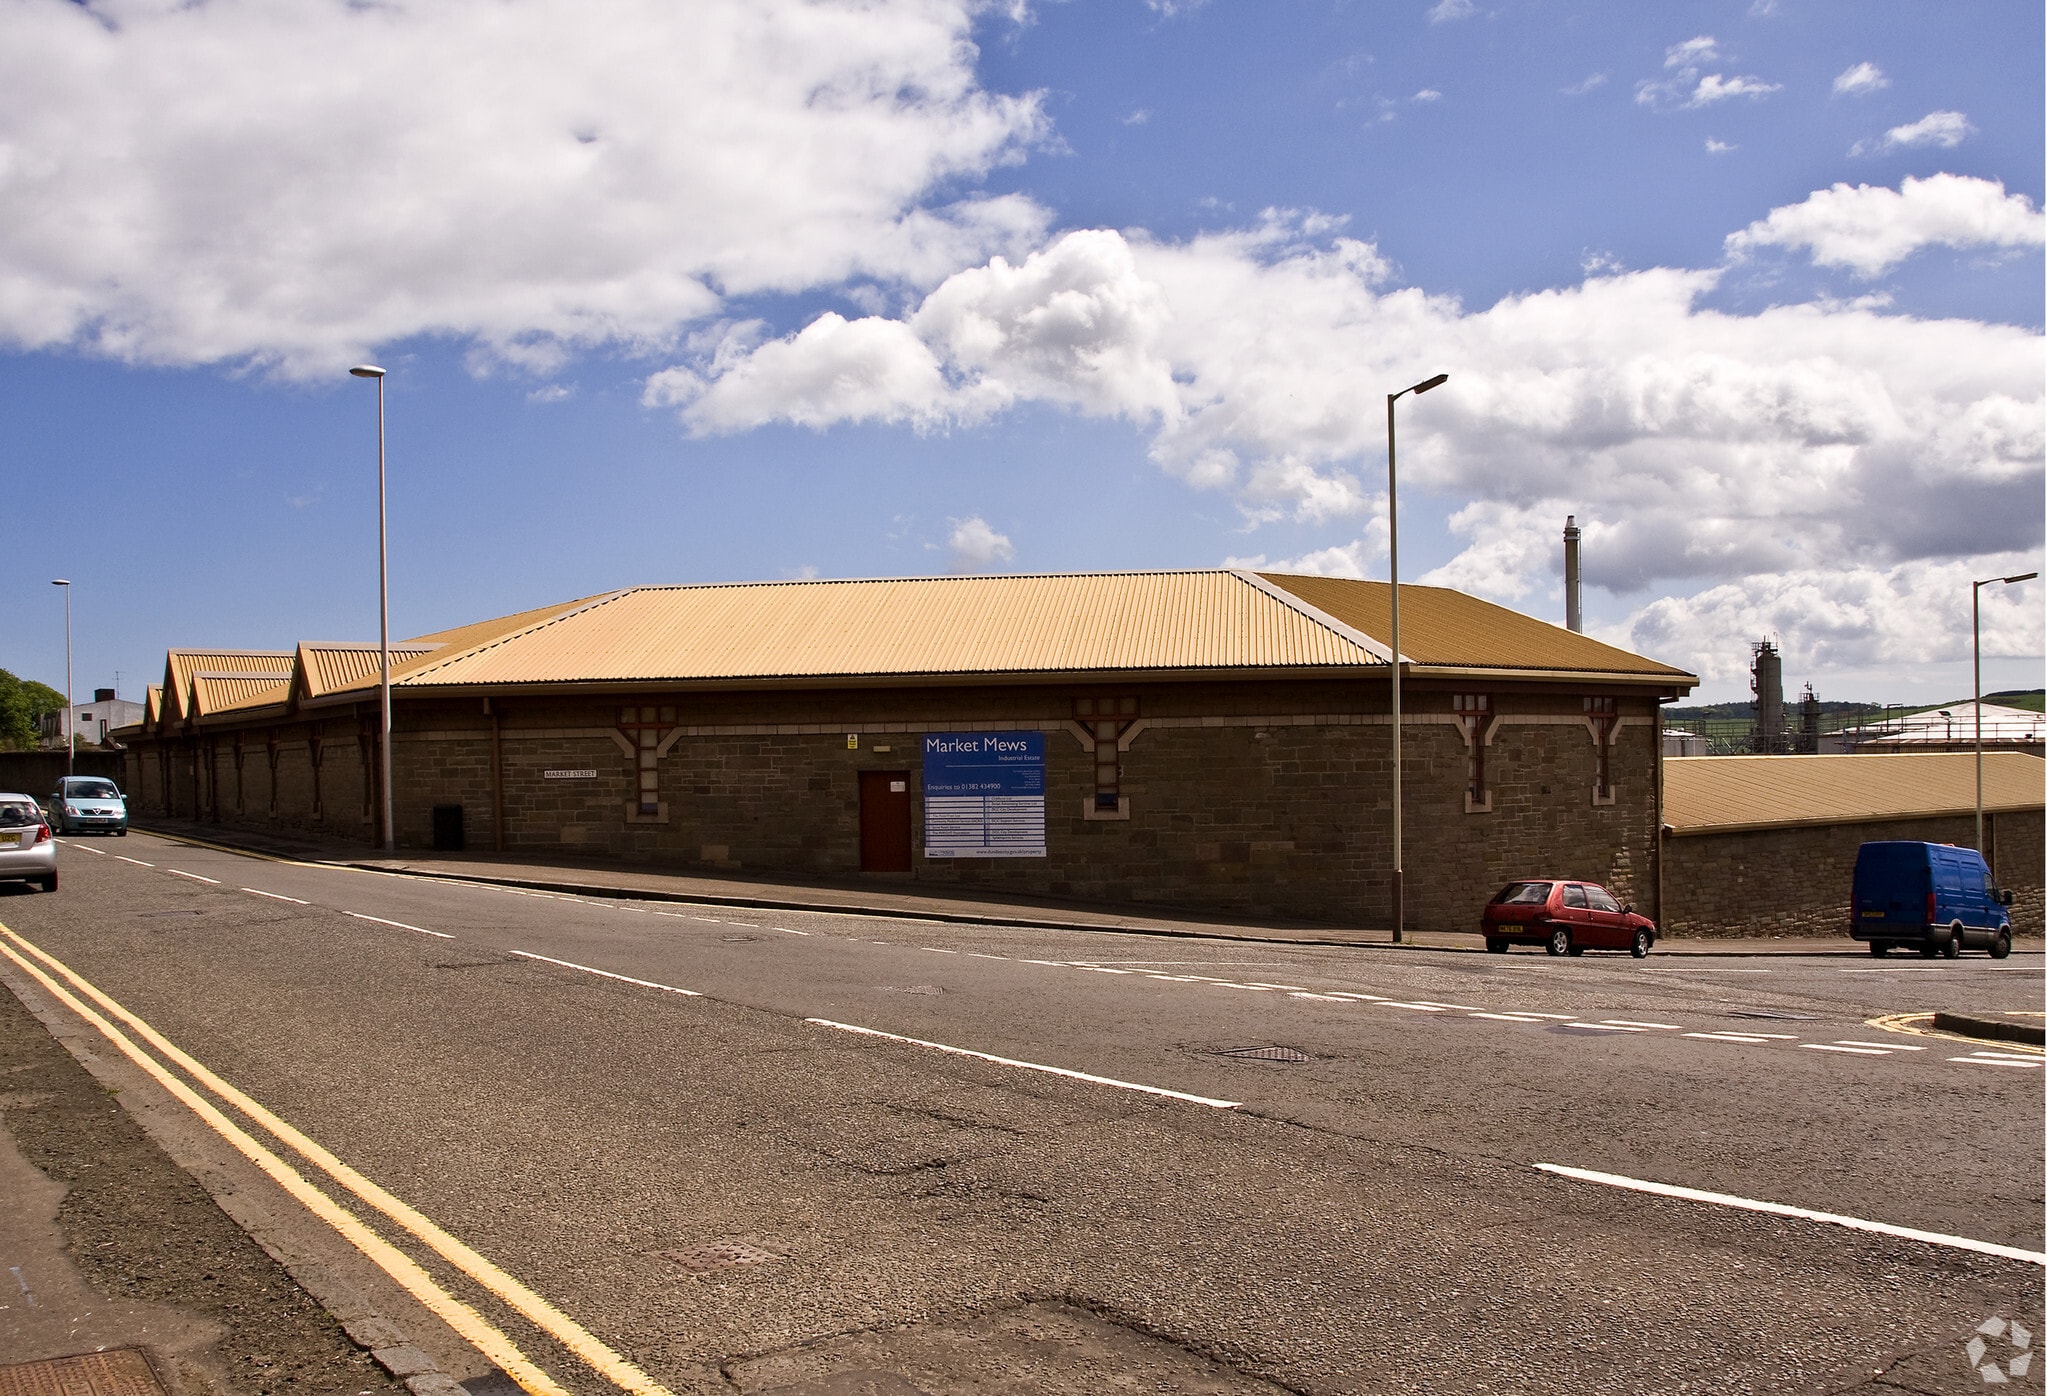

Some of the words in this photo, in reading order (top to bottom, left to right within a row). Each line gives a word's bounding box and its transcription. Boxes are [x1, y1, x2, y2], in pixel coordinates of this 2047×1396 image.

[926, 738, 979, 753] Market
[984, 737, 1027, 752] Mews
[927, 783, 953, 791] Enquiries
